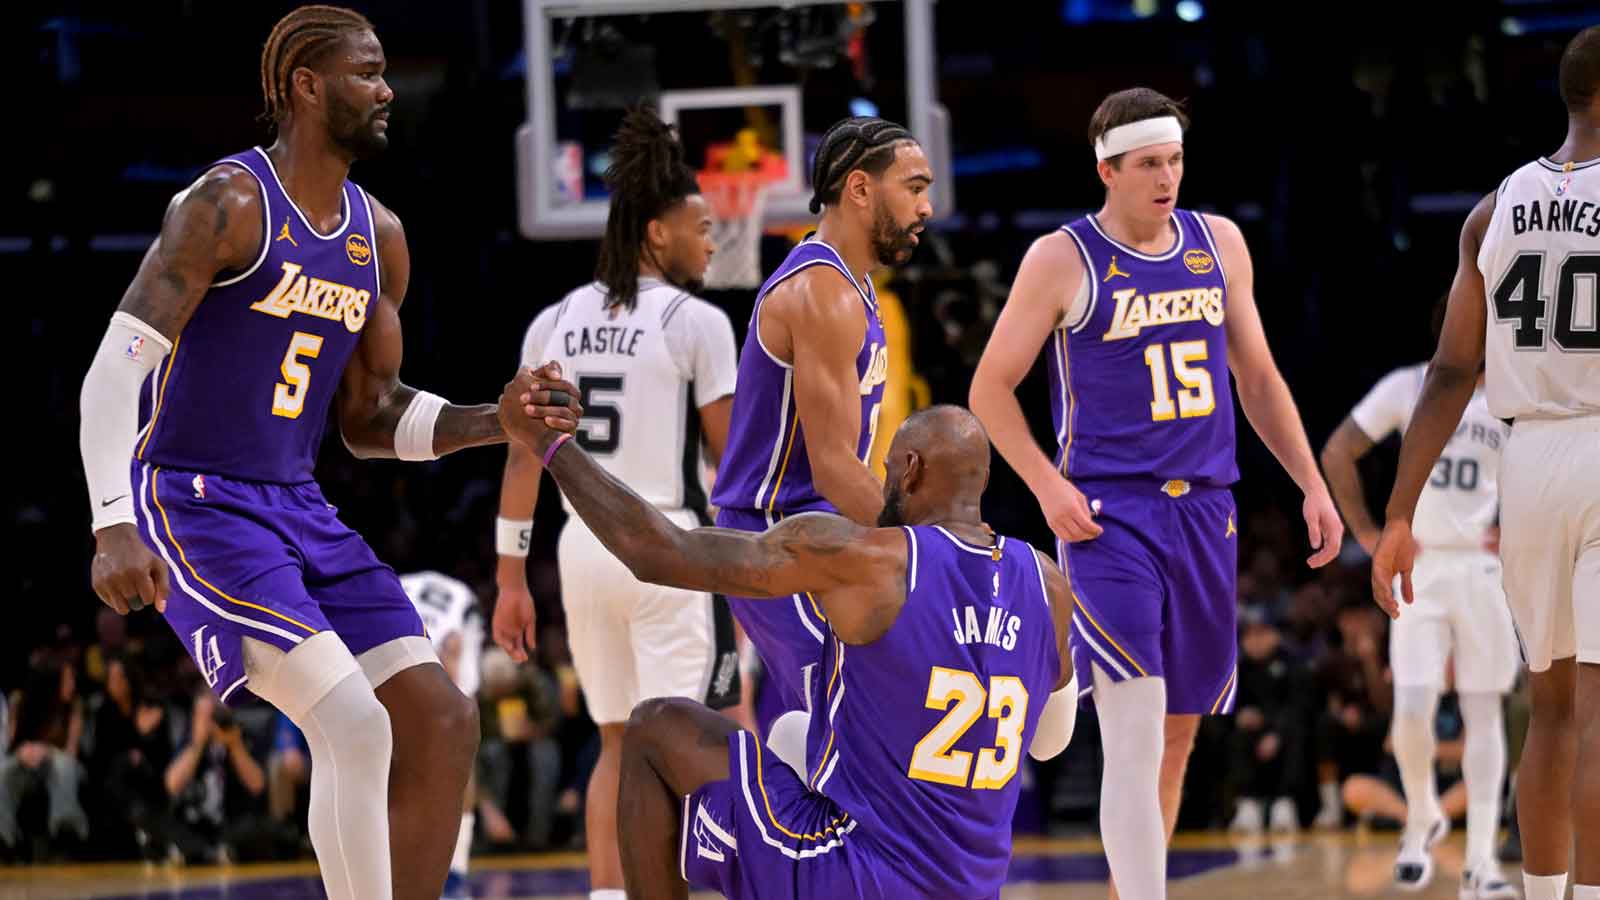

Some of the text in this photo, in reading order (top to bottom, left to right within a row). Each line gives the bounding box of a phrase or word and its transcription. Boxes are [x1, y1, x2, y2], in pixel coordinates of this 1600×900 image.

[249, 261, 371, 333] LAKERS
[1102, 287, 1225, 342] LAKERS
[1491, 250, 1600, 353] 40
[272, 330, 324, 419] 5
[564, 327, 645, 357] CASTLE
[1144, 339, 1216, 421] 15
[576, 372, 625, 457] 5
[1430, 457, 1478, 490] 30
[191, 624, 226, 689] LA
[907, 665, 1029, 790] 23
